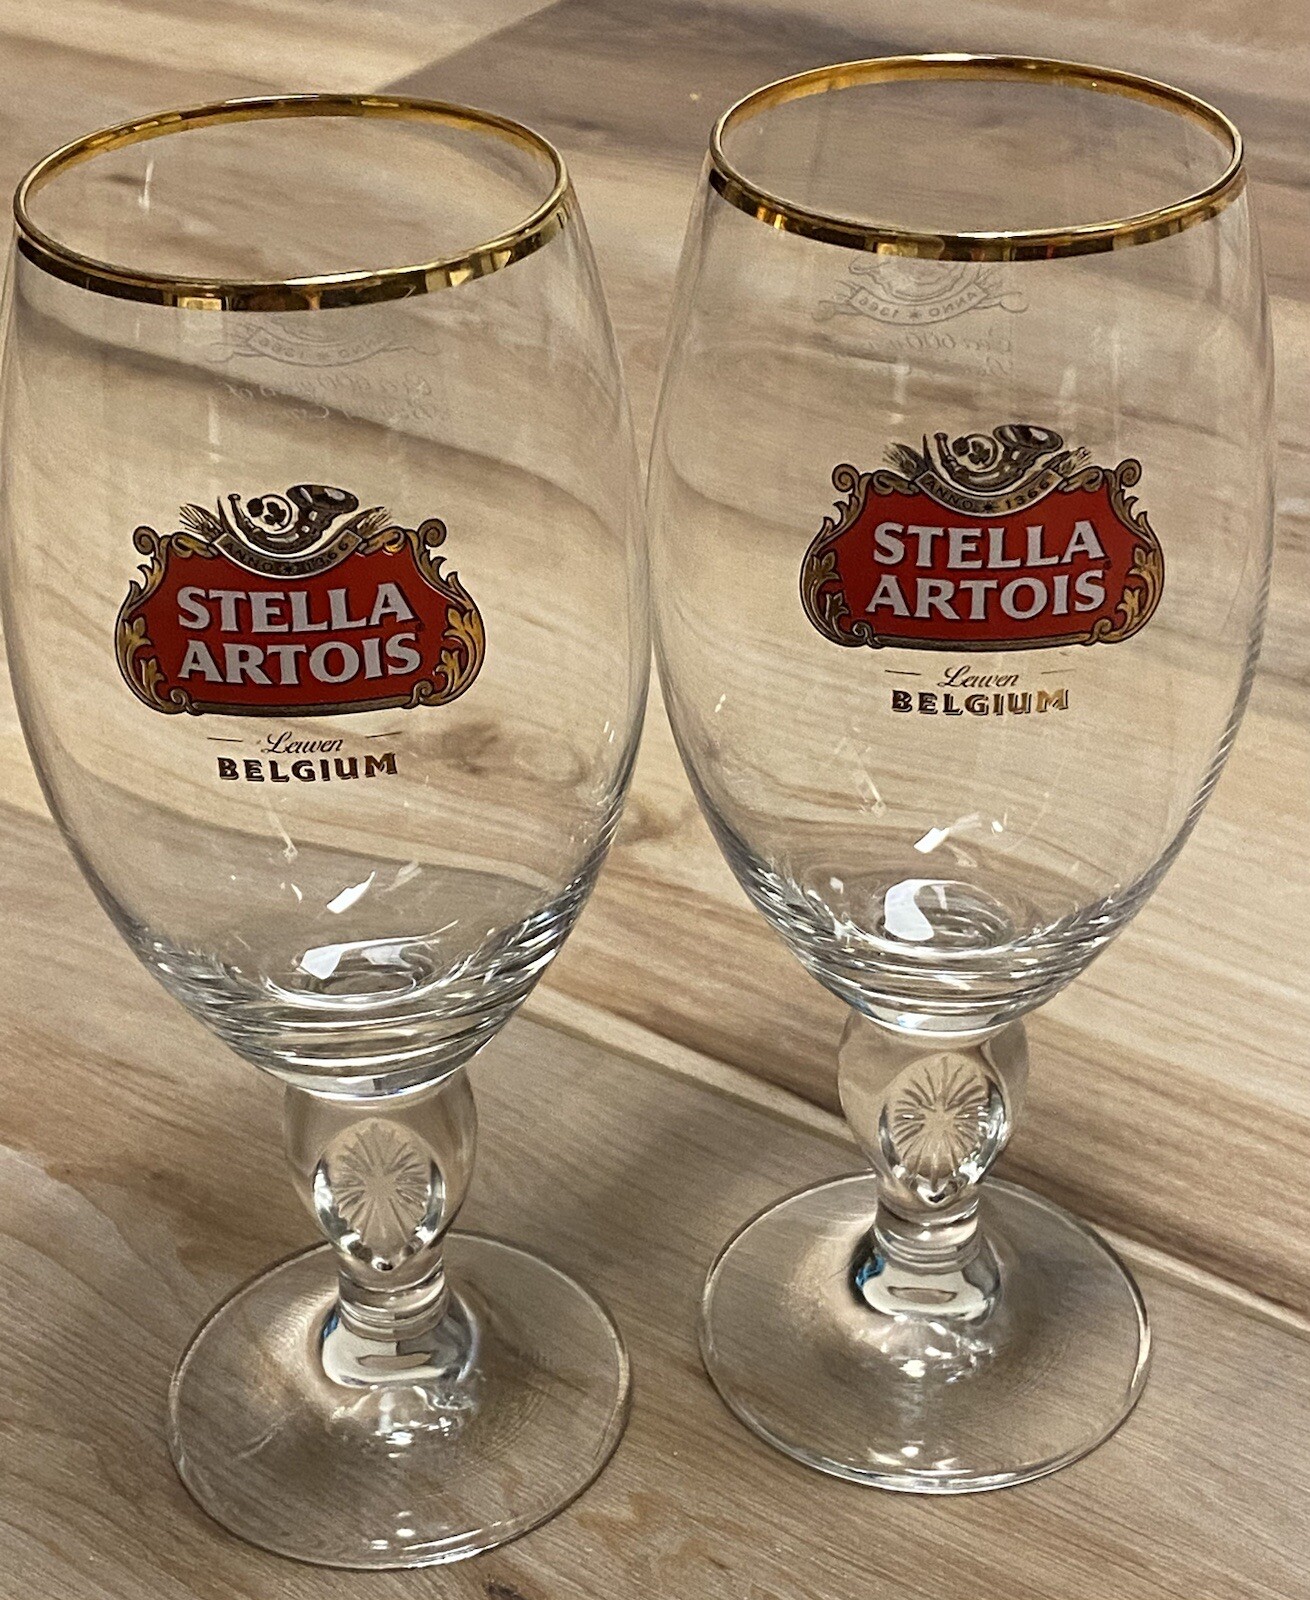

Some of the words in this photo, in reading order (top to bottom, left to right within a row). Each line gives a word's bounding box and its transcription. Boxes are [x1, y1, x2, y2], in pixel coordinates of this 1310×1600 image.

[925, 479, 974, 511] ANNO
[1004, 479, 1051, 510] 1366
[872, 519, 1106, 569] STELLA
[176, 581, 415, 633] STELLA
[865, 569, 1107, 620] ARTOIS
[177, 631, 422, 685] ARTOIS
[937, 664, 1020, 688] Leuven
[892, 688, 1070, 716] BELGIUM
[260, 730, 344, 755] Leuven
[217, 751, 399, 783] BELGIUM
